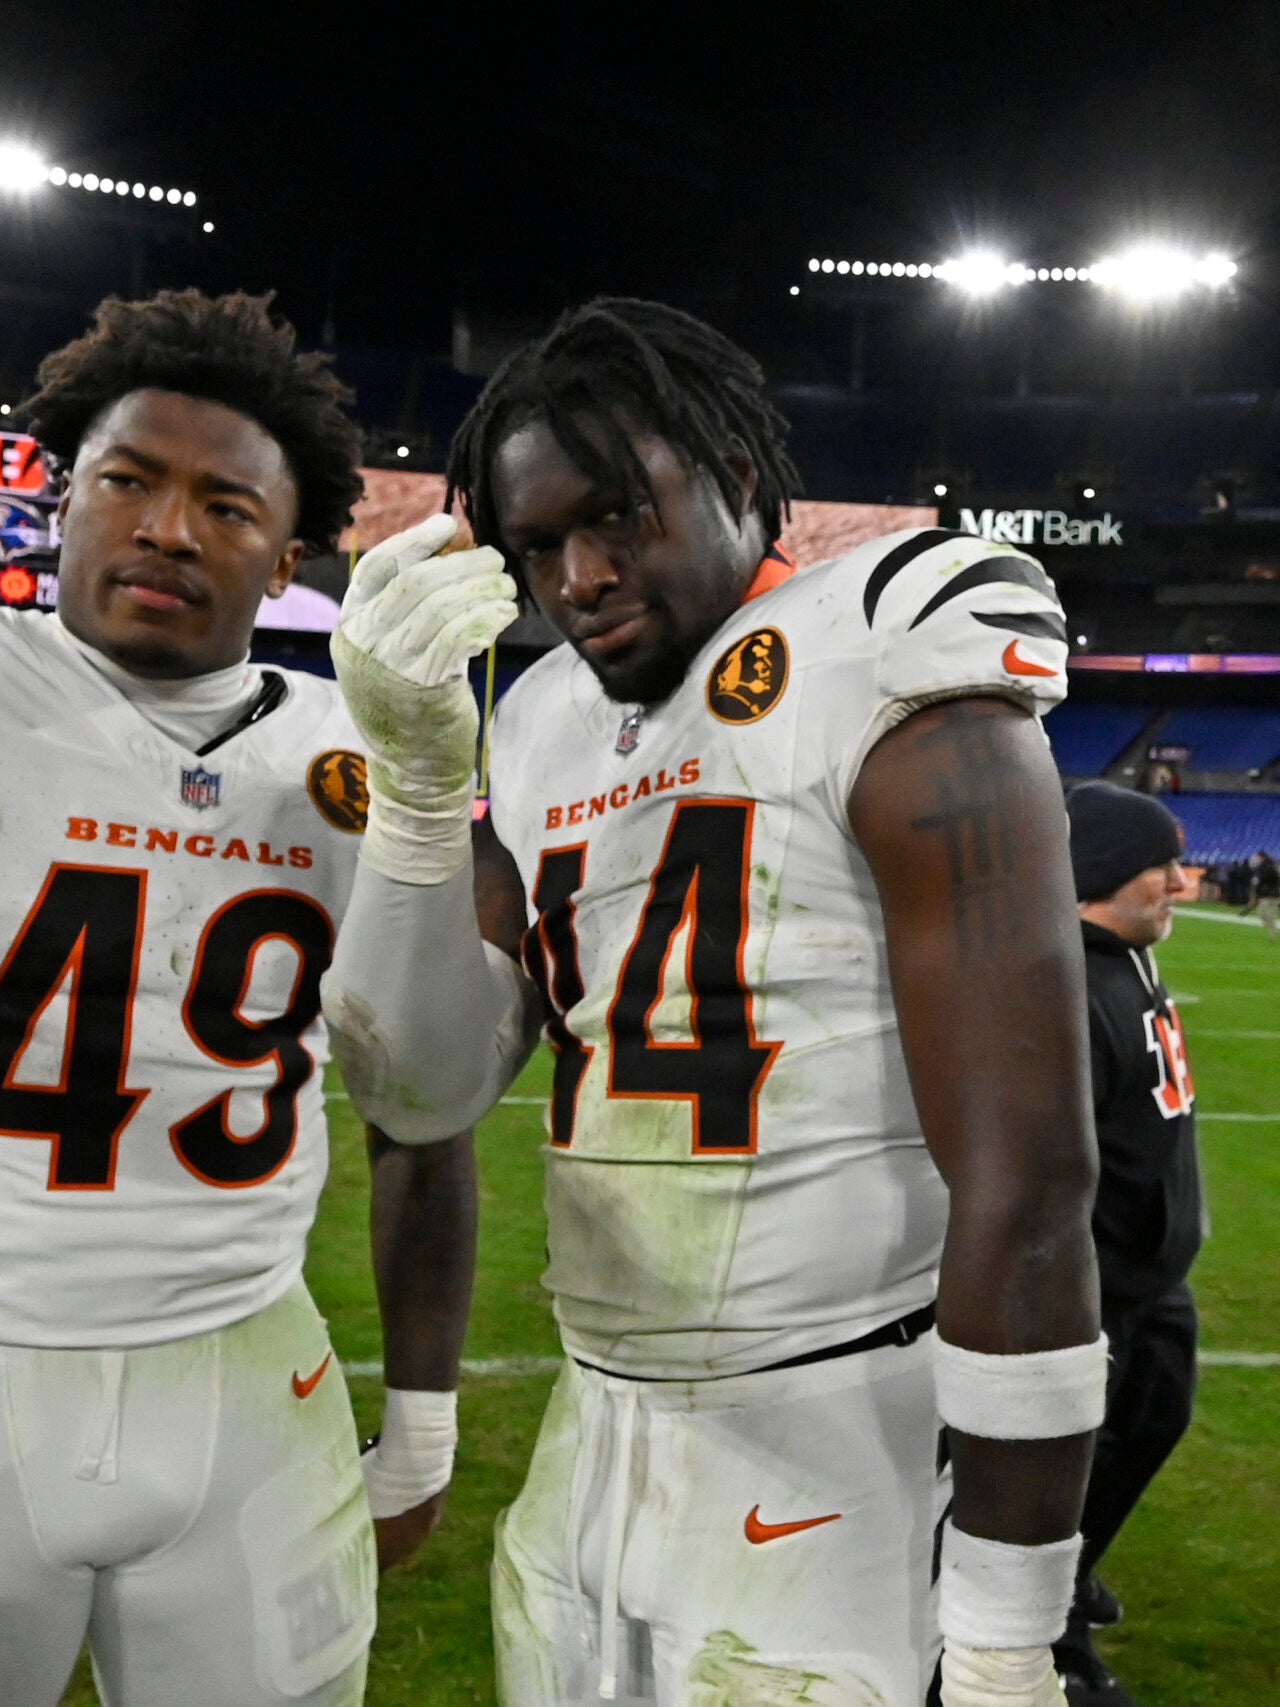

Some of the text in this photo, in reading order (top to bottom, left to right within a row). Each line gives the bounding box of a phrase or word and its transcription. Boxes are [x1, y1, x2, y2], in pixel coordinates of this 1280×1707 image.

[959, 508, 1123, 546] M&T Bank
[545, 758, 700, 830] BENGALS
[64, 816, 314, 869] BENGALS
